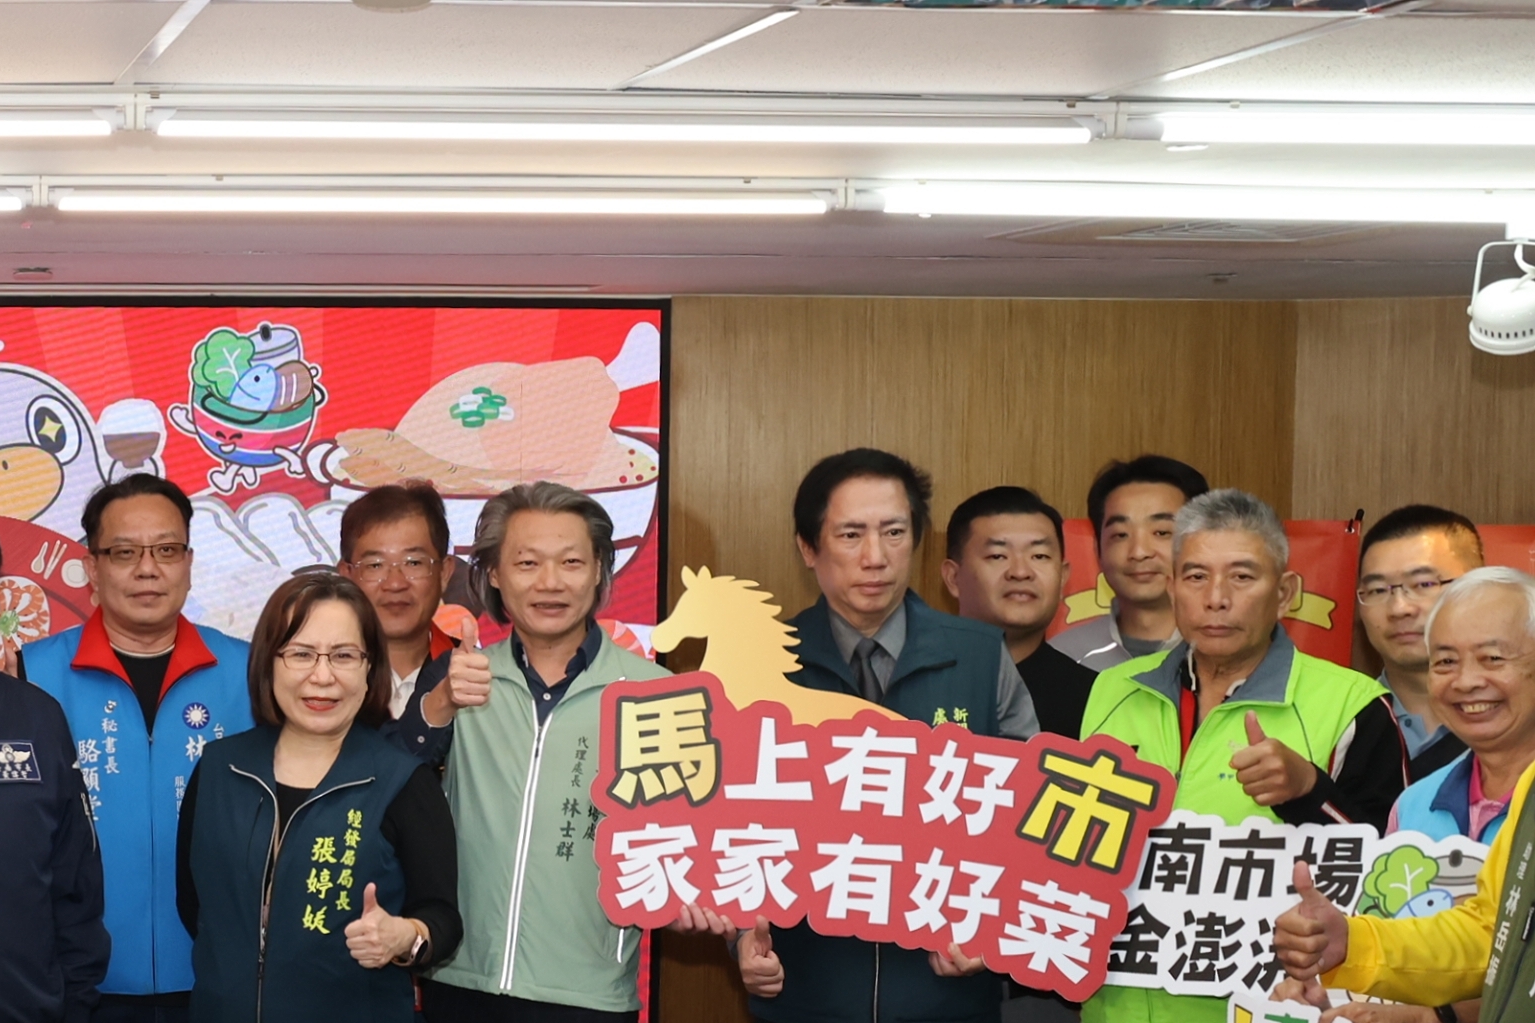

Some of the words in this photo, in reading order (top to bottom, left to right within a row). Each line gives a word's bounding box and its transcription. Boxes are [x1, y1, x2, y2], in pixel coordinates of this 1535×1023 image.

[101, 718, 120, 774] 秘書長
[571, 736, 589, 788] 代理處長
[607, 689, 1159, 870] 馬上有好市
[334, 808, 362, 911] 經發局局長
[555, 798, 582, 862] 林士群
[302, 836, 338, 935] 張婷媛
[610, 822, 1111, 985] 家家有好菜
